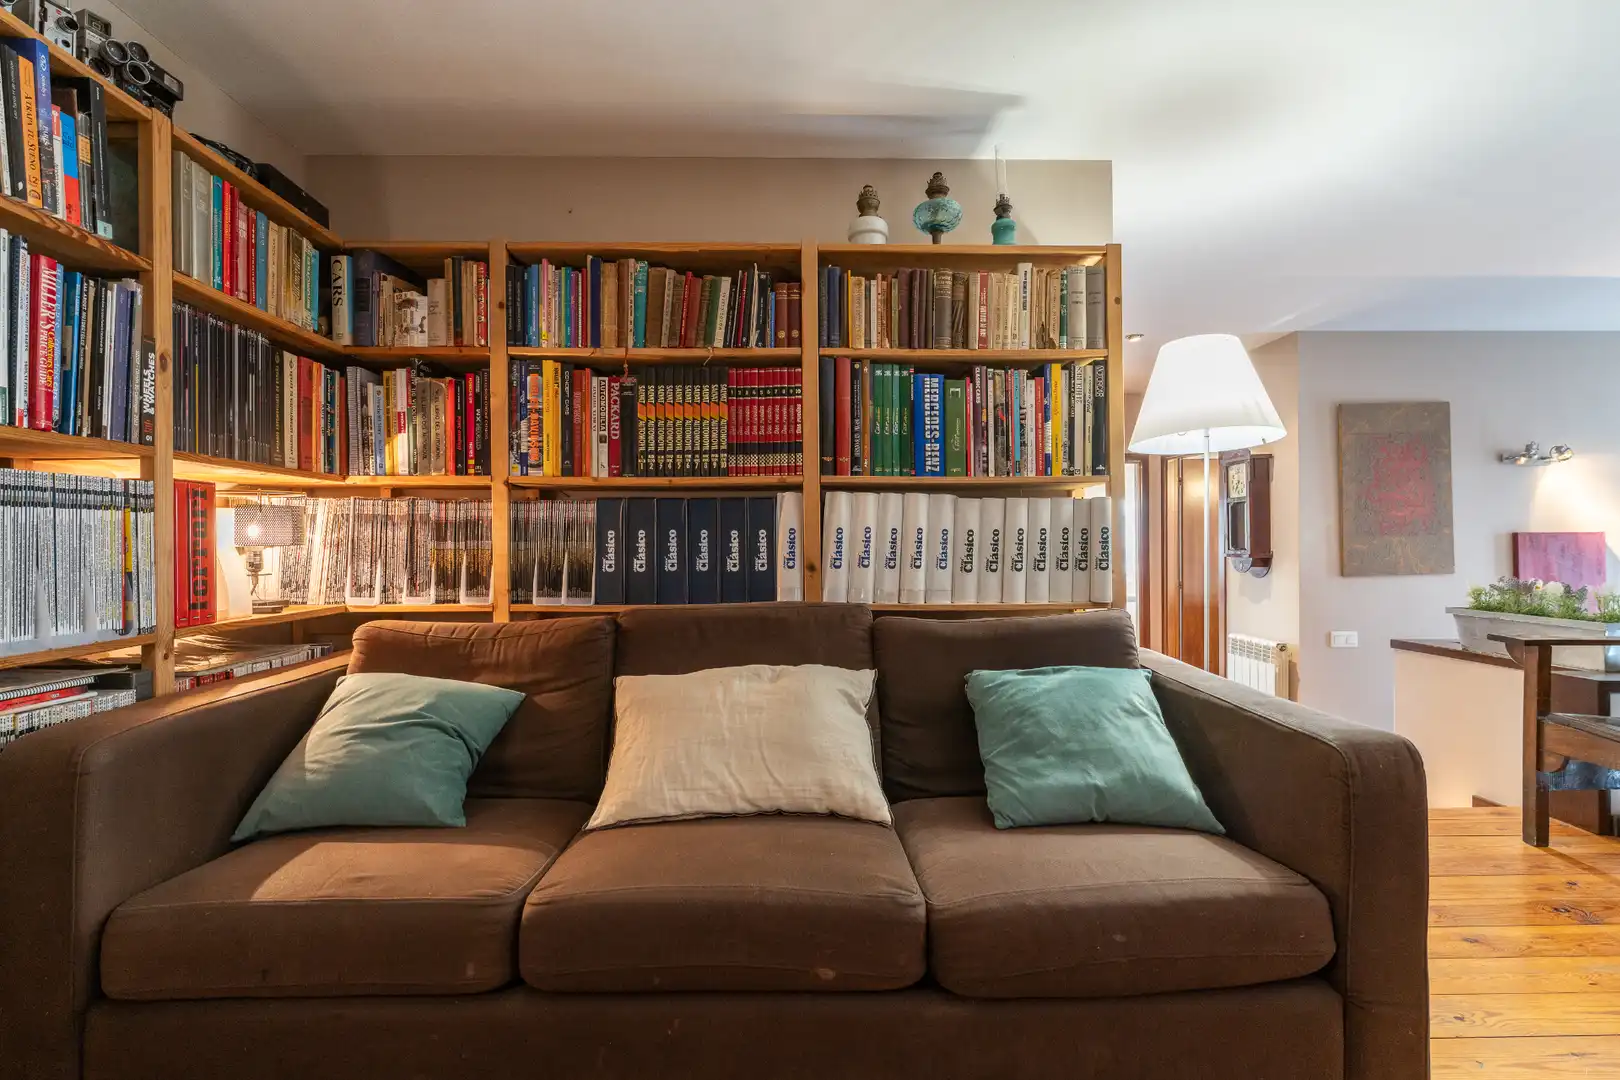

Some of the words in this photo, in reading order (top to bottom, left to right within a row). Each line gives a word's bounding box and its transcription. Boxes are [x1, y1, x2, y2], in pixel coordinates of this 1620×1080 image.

[39, 266, 56, 331] MILLER'S
[332, 260, 343, 306] CARS
[149, 406, 154, 415] &
[530, 374, 540, 461] HARLEY-DAVIDSON
[611, 382, 620, 440] PACKARD
[924, 378, 940, 472] MERCEDES-BENZ
[606, 530, 615, 572] Clásico
[636, 530, 646, 572] Clásico
[668, 529, 677, 572] Clásico
[699, 530, 708, 571] Clásico
[730, 530, 739, 572] Clásico
[758, 529, 766, 571] Clásico
[787, 528, 796, 569] Clásico
[834, 527, 843, 569] Clásico
[861, 526, 871, 568] Clásico
[888, 528, 898, 569] Clásico
[913, 527, 923, 569] Clásico
[939, 528, 949, 570] Clásico
[964, 529, 974, 573] Clásico
[989, 529, 999, 573] Clásico
[1015, 528, 1024, 572] Clásico
[1037, 528, 1047, 571] Clásico
[1060, 527, 1069, 571] Clásico
[1079, 528, 1088, 571] Clásico
[1100, 526, 1109, 571] Clásico
